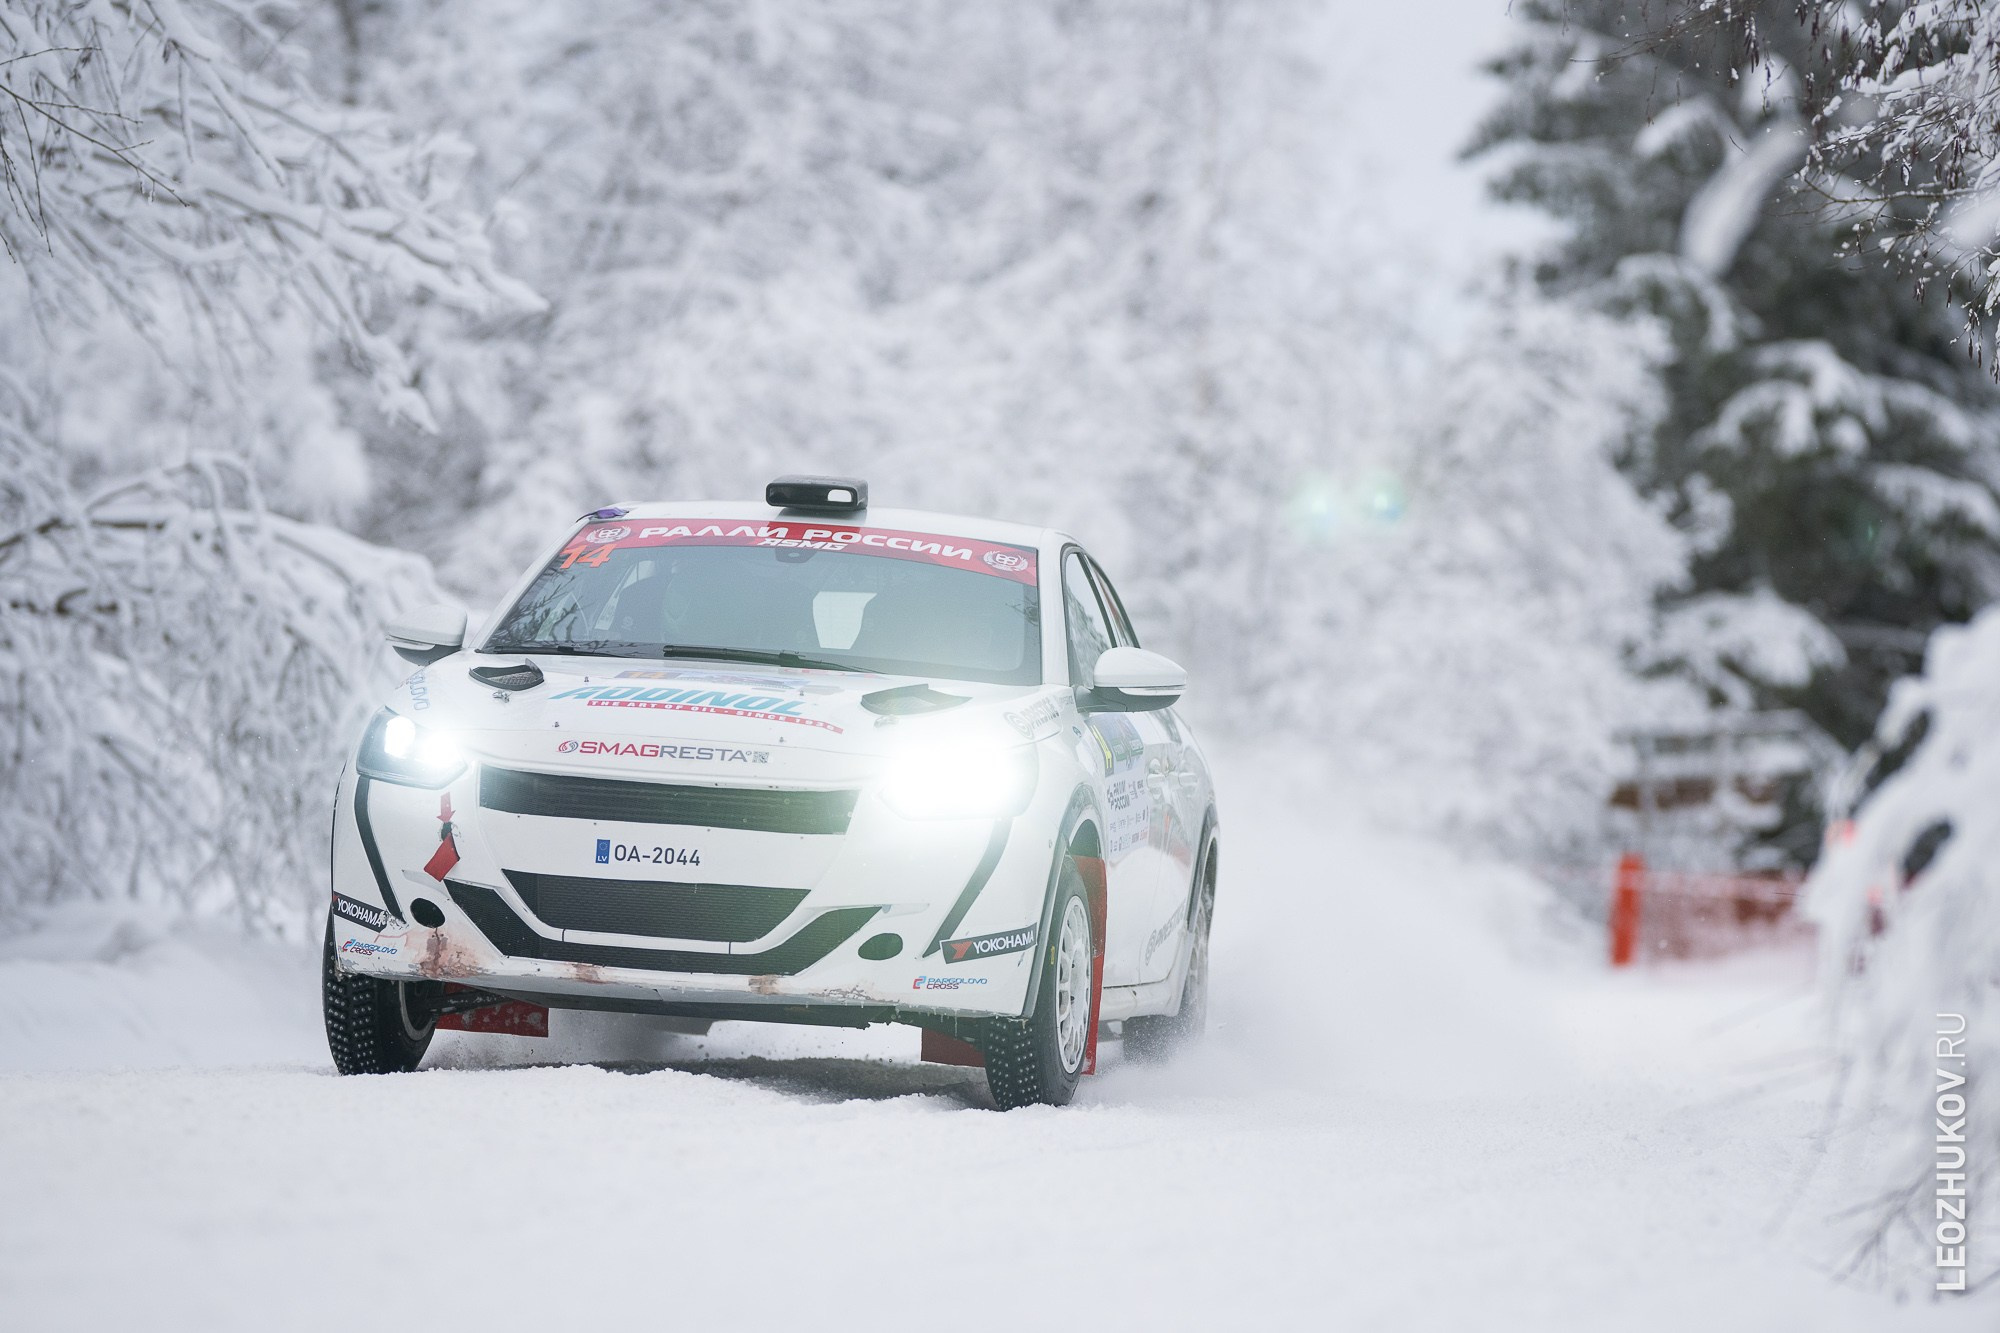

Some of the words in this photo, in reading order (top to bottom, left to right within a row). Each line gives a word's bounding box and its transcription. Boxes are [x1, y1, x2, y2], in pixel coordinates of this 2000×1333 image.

[639, 525, 788, 539] РАЛЛИ
[802, 528, 973, 561] РОССИИ
[559, 543, 619, 570] 14
[548, 685, 806, 716] ADDINOL
[691, 706, 717, 714] OIL
[735, 710, 787, 722] SINCE
[614, 844, 701, 866] OA-2044
[337, 898, 382, 928] YOKOHAMA
[350, 946, 373, 956] CROSS
[354, 941, 398, 955] PARGOLOVO
[973, 930, 1035, 954] YOKOHAMA
[928, 977, 988, 985] PARGOLOVO
